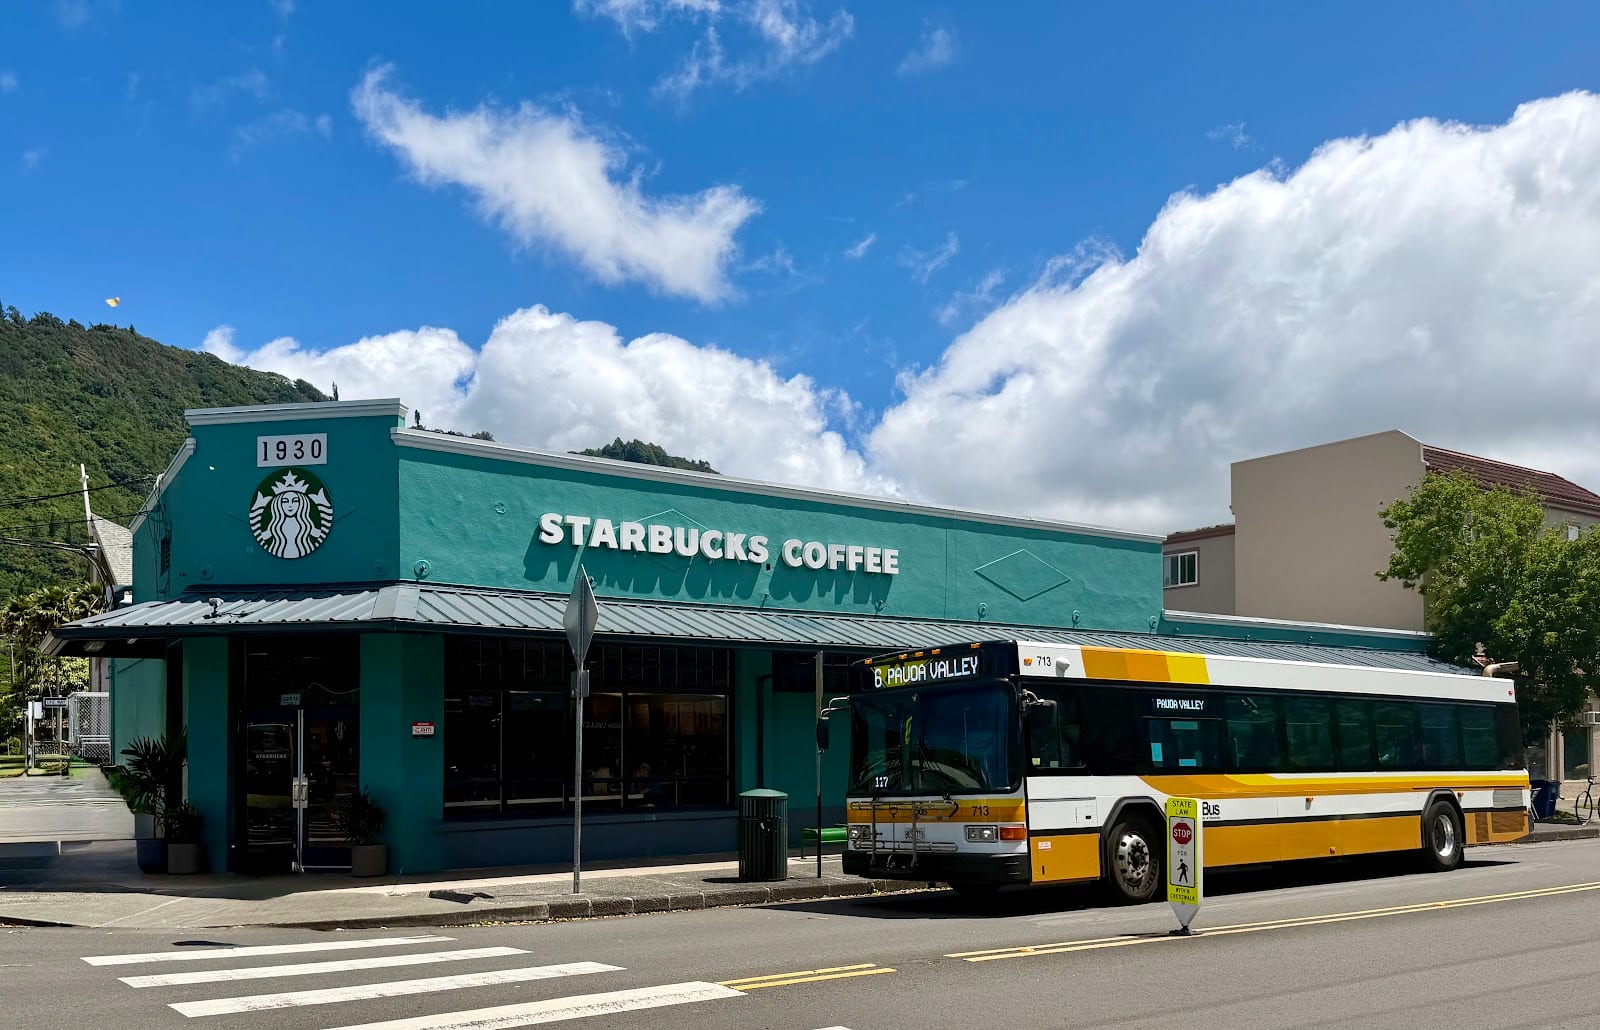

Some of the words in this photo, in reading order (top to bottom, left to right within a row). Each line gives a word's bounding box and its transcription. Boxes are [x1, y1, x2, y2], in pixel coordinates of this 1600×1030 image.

[262, 439, 322, 462] 1930
[538, 512, 769, 563] STARBUCKS
[781, 538, 899, 575] COFFEE
[1036, 655, 1051, 667] 713
[874, 668, 882, 688] 6
[929, 656, 978, 680] VALLEY
[1178, 699, 1204, 710] VALLEY
[1172, 800, 1192, 808] STATE
[971, 805, 989, 817] 713
[1175, 808, 1189, 816] LAW
[1173, 828, 1191, 838] STOP
